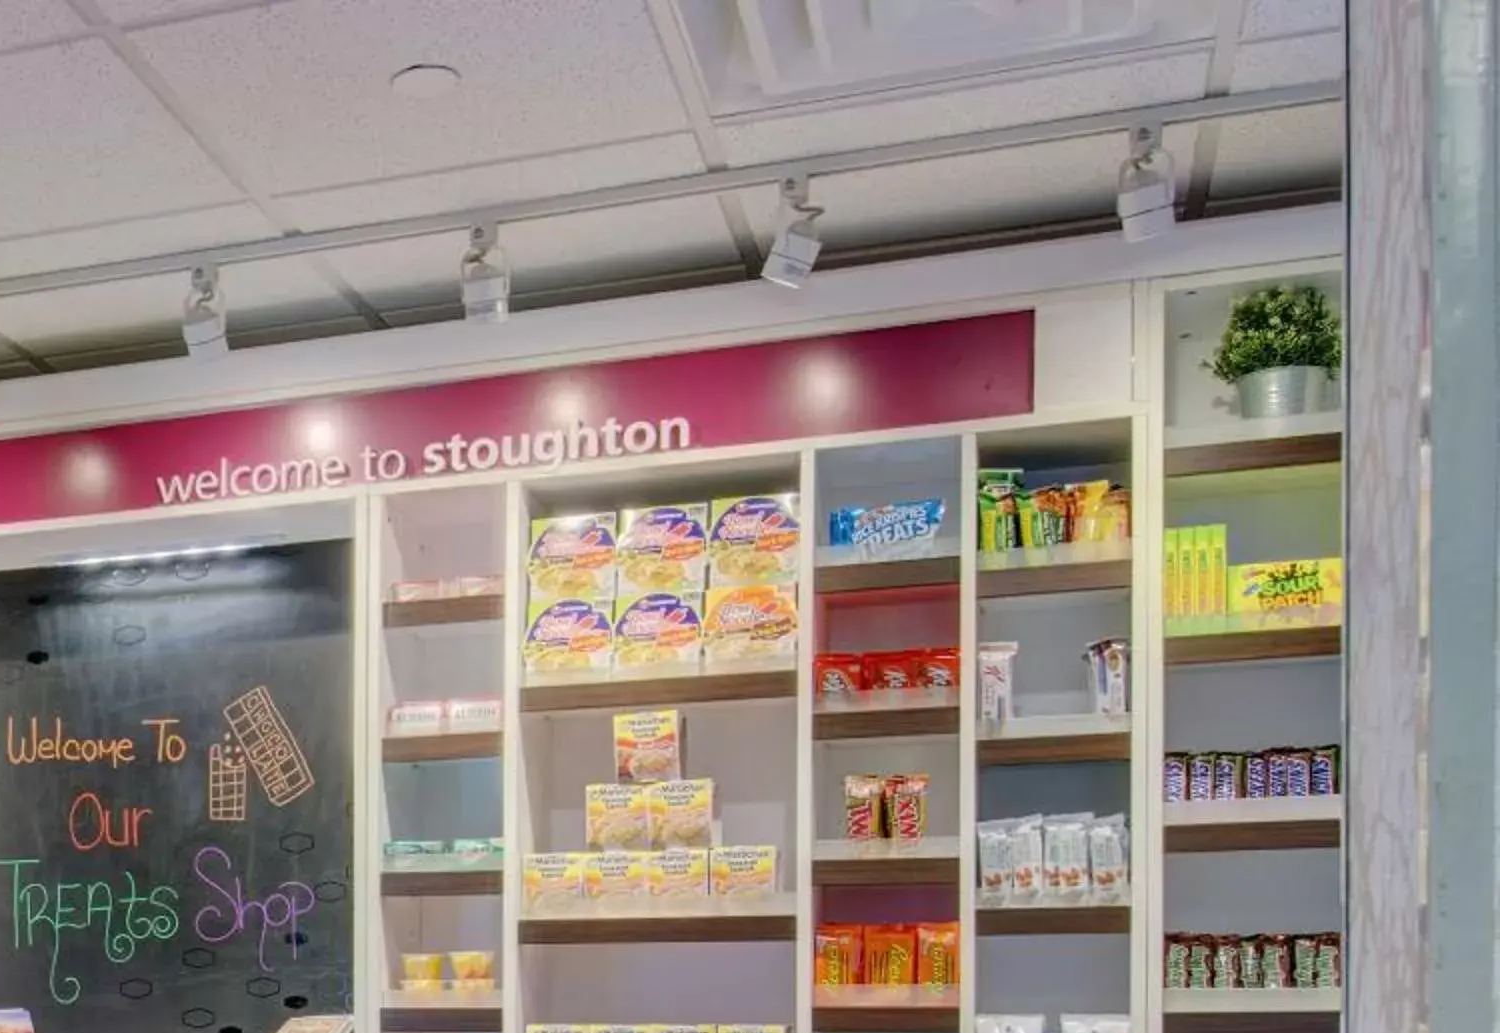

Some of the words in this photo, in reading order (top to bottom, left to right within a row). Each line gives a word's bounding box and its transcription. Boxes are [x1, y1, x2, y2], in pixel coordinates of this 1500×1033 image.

[157, 456, 347, 505] welcome
[360, 445, 407, 480] to
[423, 416, 691, 473] stoughton
[1261, 576, 1320, 595] SOUR
[7, 716, 136, 768] Welcome
[142, 718, 187, 763] To
[68, 791, 153, 850] Our
[194, 846, 317, 972] Shop
